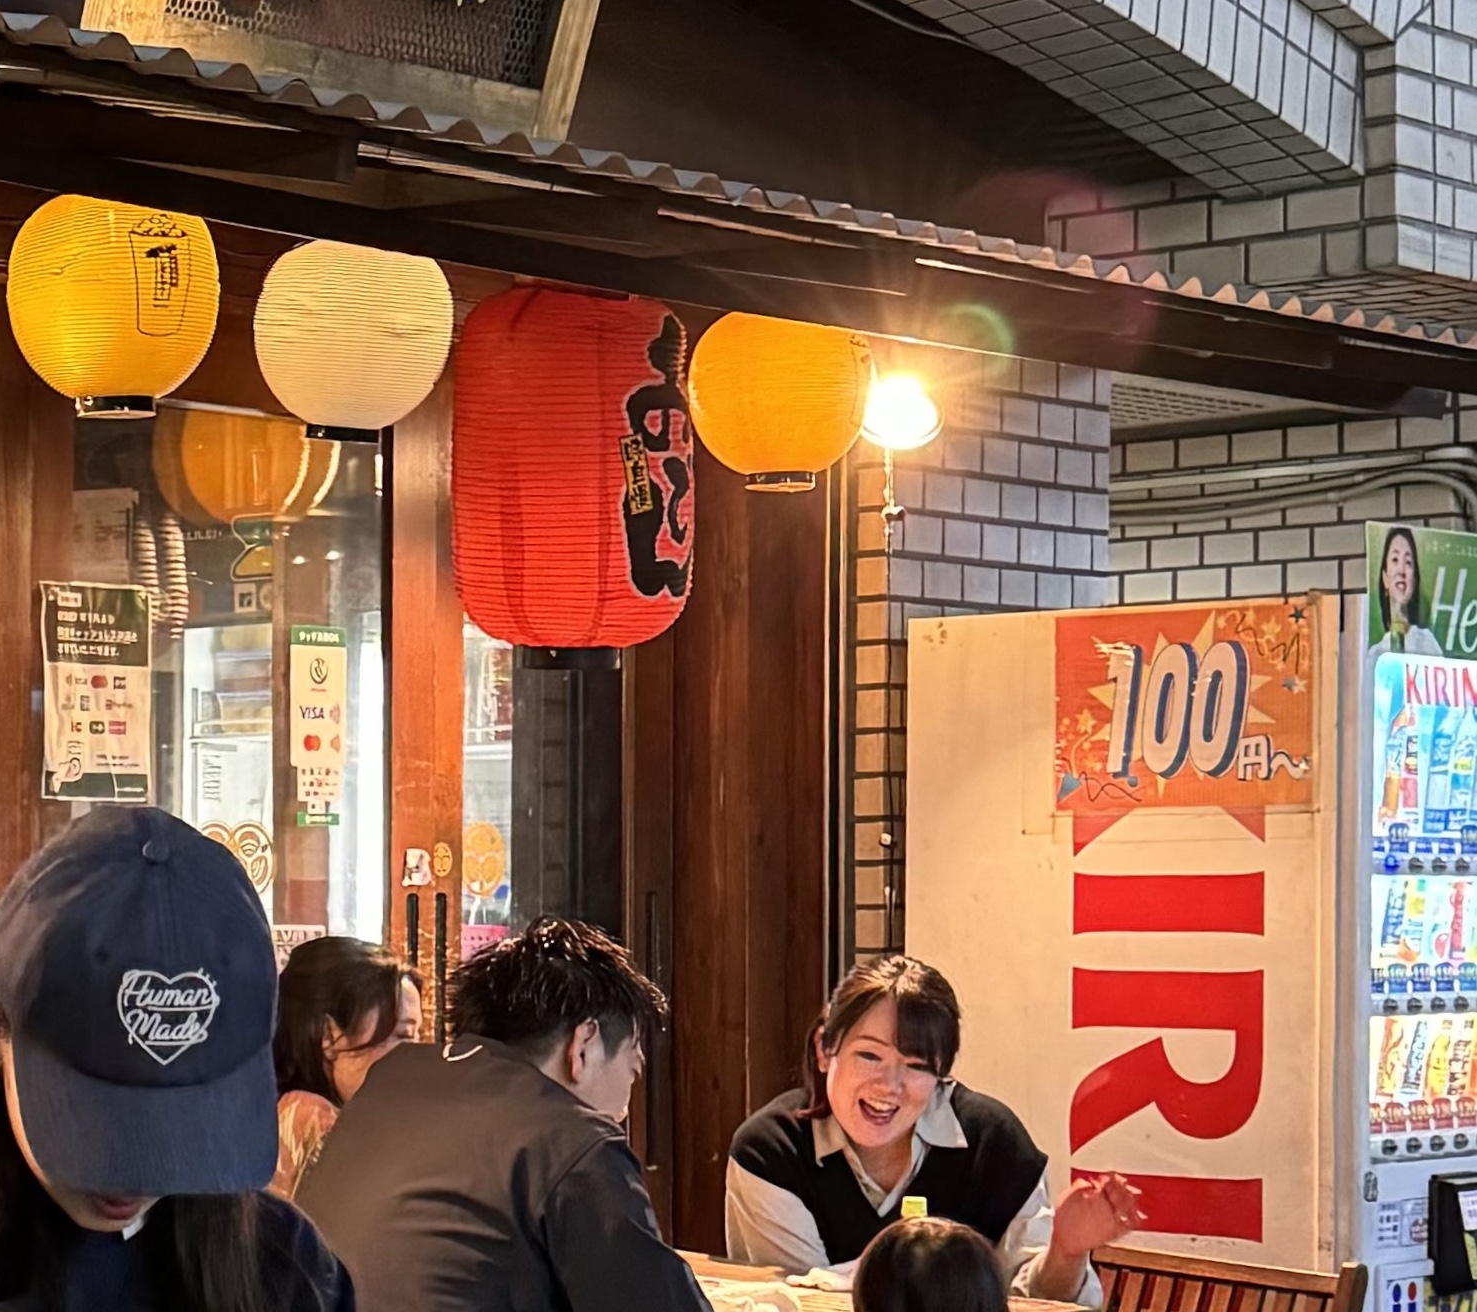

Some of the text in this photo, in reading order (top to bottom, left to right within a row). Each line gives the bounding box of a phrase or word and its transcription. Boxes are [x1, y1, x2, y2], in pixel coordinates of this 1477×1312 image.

[300, 706, 324, 719] VISA
[123, 970, 220, 1008] Human
[126, 1008, 208, 1045] Made
